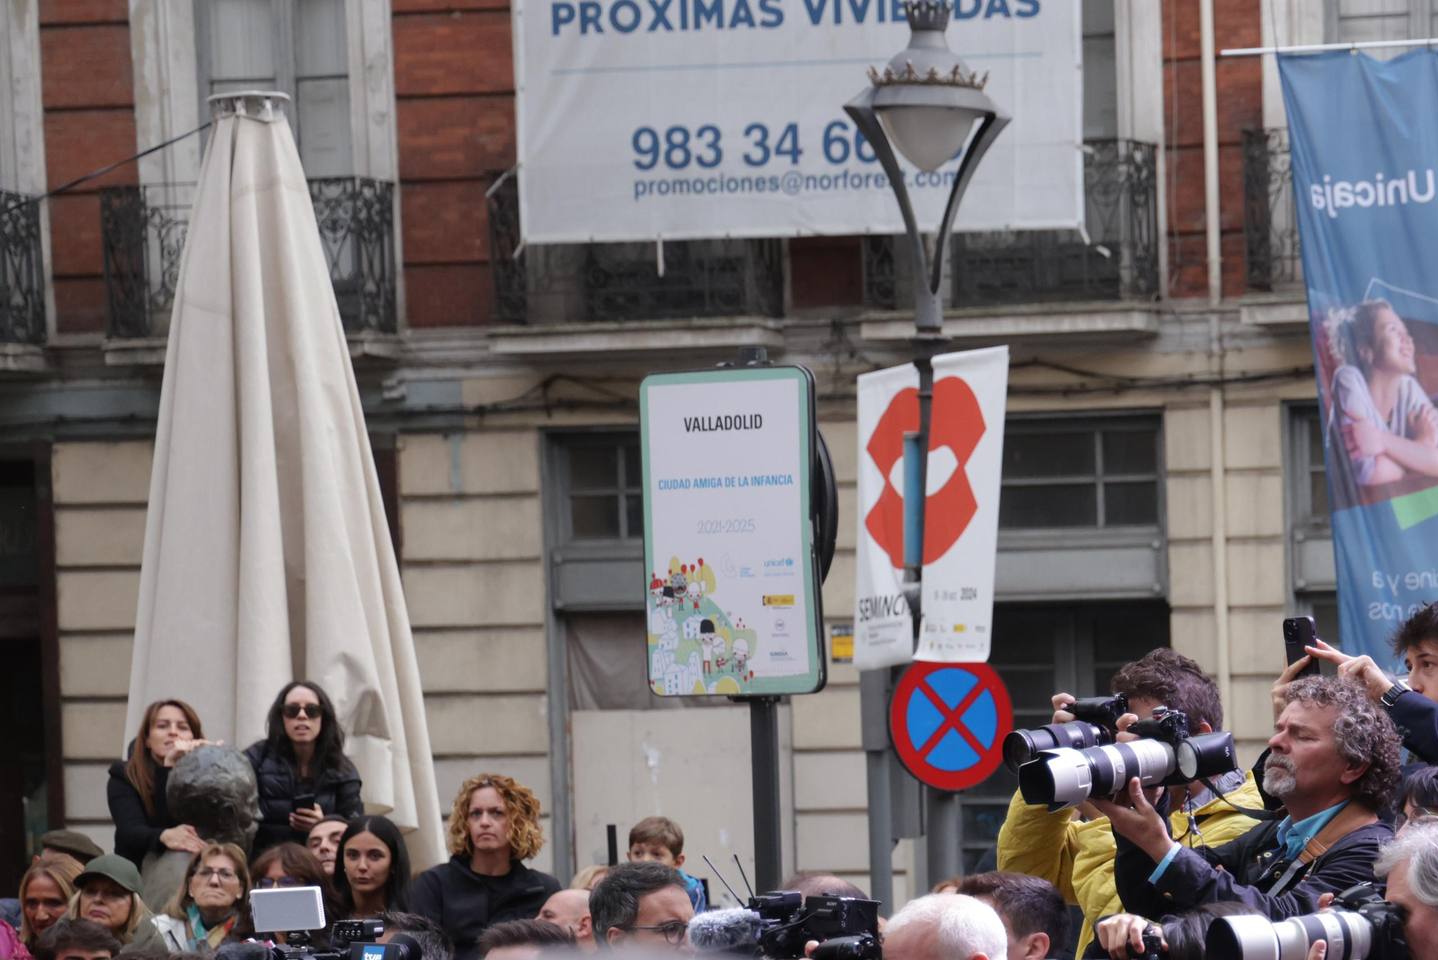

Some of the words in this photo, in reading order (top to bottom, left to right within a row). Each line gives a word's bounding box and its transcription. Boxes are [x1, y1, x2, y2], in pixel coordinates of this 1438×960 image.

[803, 0, 1040, 25] VIVIEDAS
[632, 123, 723, 171] 983
[742, 121, 803, 167] 34
[684, 414, 763, 433] VALLADOLID
[658, 478, 691, 490] CIUDAD
[693, 477, 722, 489] AMIGA
[724, 476, 736, 488] DE
[738, 476, 749, 487] LA
[751, 474, 793, 486] INFANCIA
